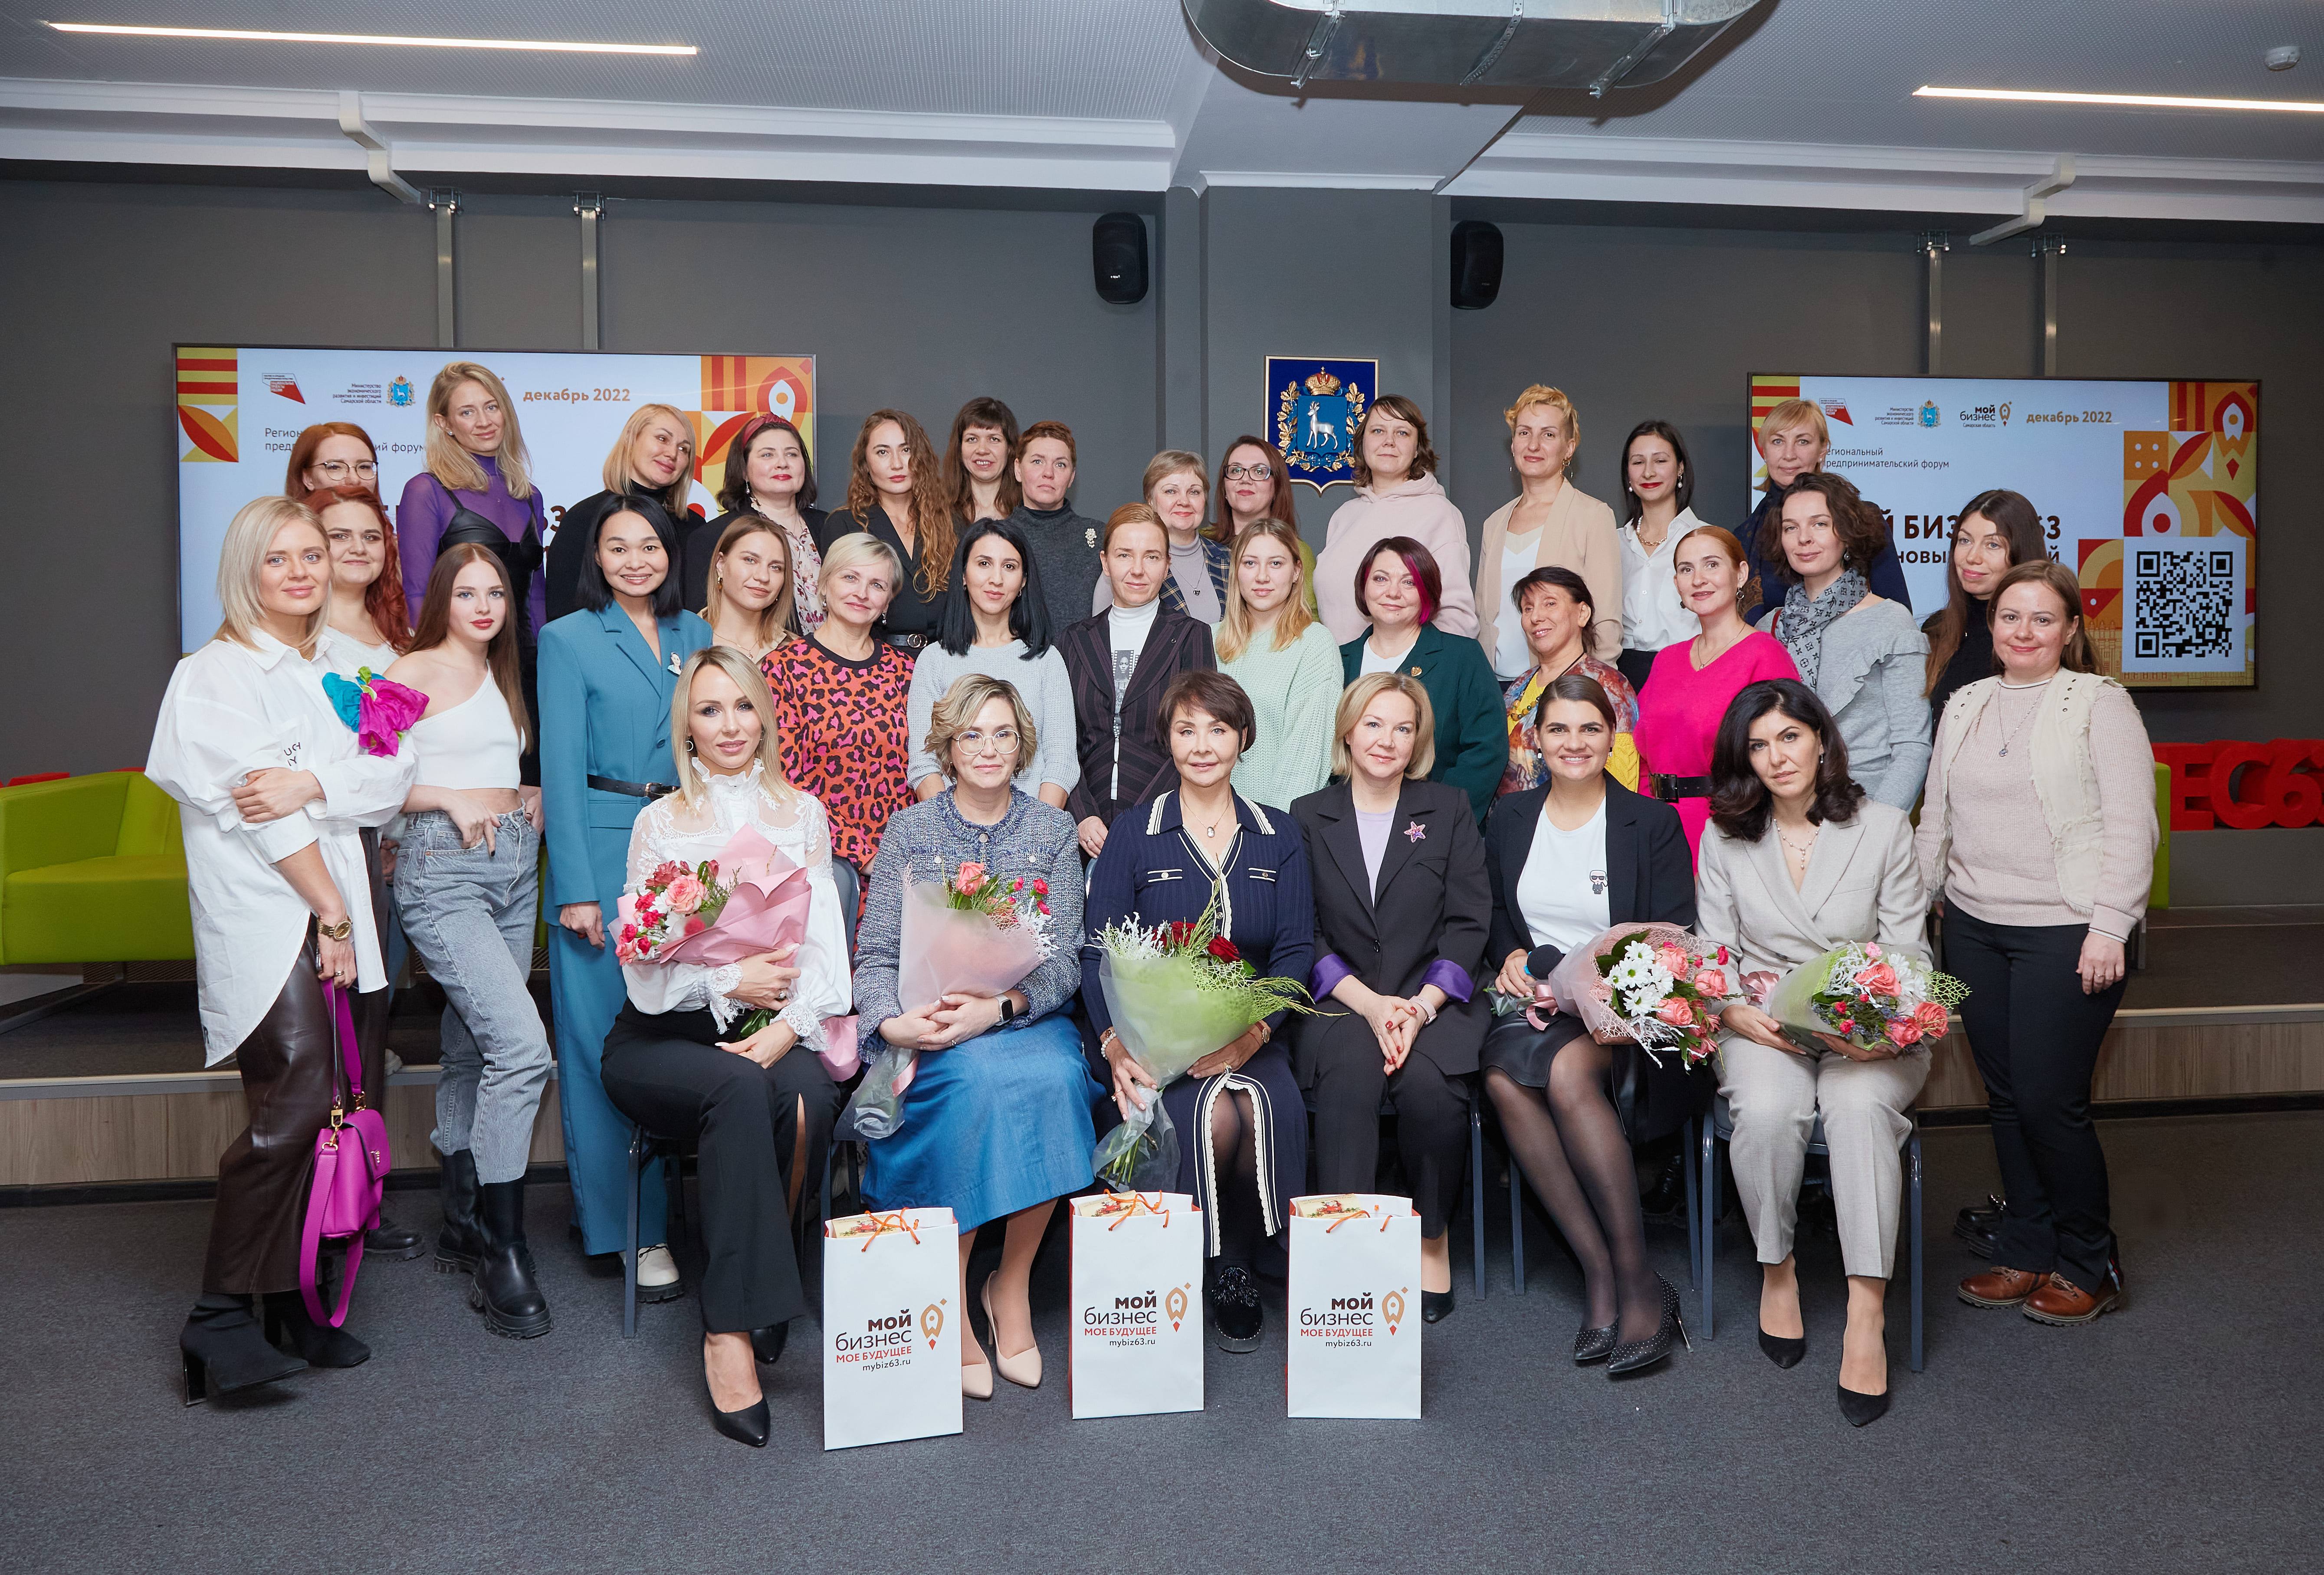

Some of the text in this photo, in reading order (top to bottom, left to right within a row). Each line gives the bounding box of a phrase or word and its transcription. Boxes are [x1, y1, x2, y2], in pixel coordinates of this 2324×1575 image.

[523, 388, 630, 404] декабрь 2022
[1975, 404, 1995, 413] мой
[1960, 411, 1996, 421] бизнес
[2026, 411, 2112, 425] декабрь 2022
[1825, 459, 1949, 470] редпринимательский форум
[1115, 1290, 1156, 1309] мой
[1331, 1292, 1373, 1310] мой
[868, 1309, 911, 1332] мой
[1084, 1306, 1157, 1325] бизнес
[1300, 1308, 1373, 1326] бизнес
[1109, 1326, 1157, 1337] БУДУЩЕЕ
[1300, 1329, 1373, 1337] МОЕ БУДУЩЕЕ
[836, 1330, 912, 1351] бизнес
[1109, 1338, 1155, 1348] mybiz63.ru
[1326, 1339, 1372, 1349] mybiz63.ru
[836, 1346, 912, 1363] МОЕ БУДУЩЕЕ
[863, 1359, 910, 1372] mybiz63.ru
